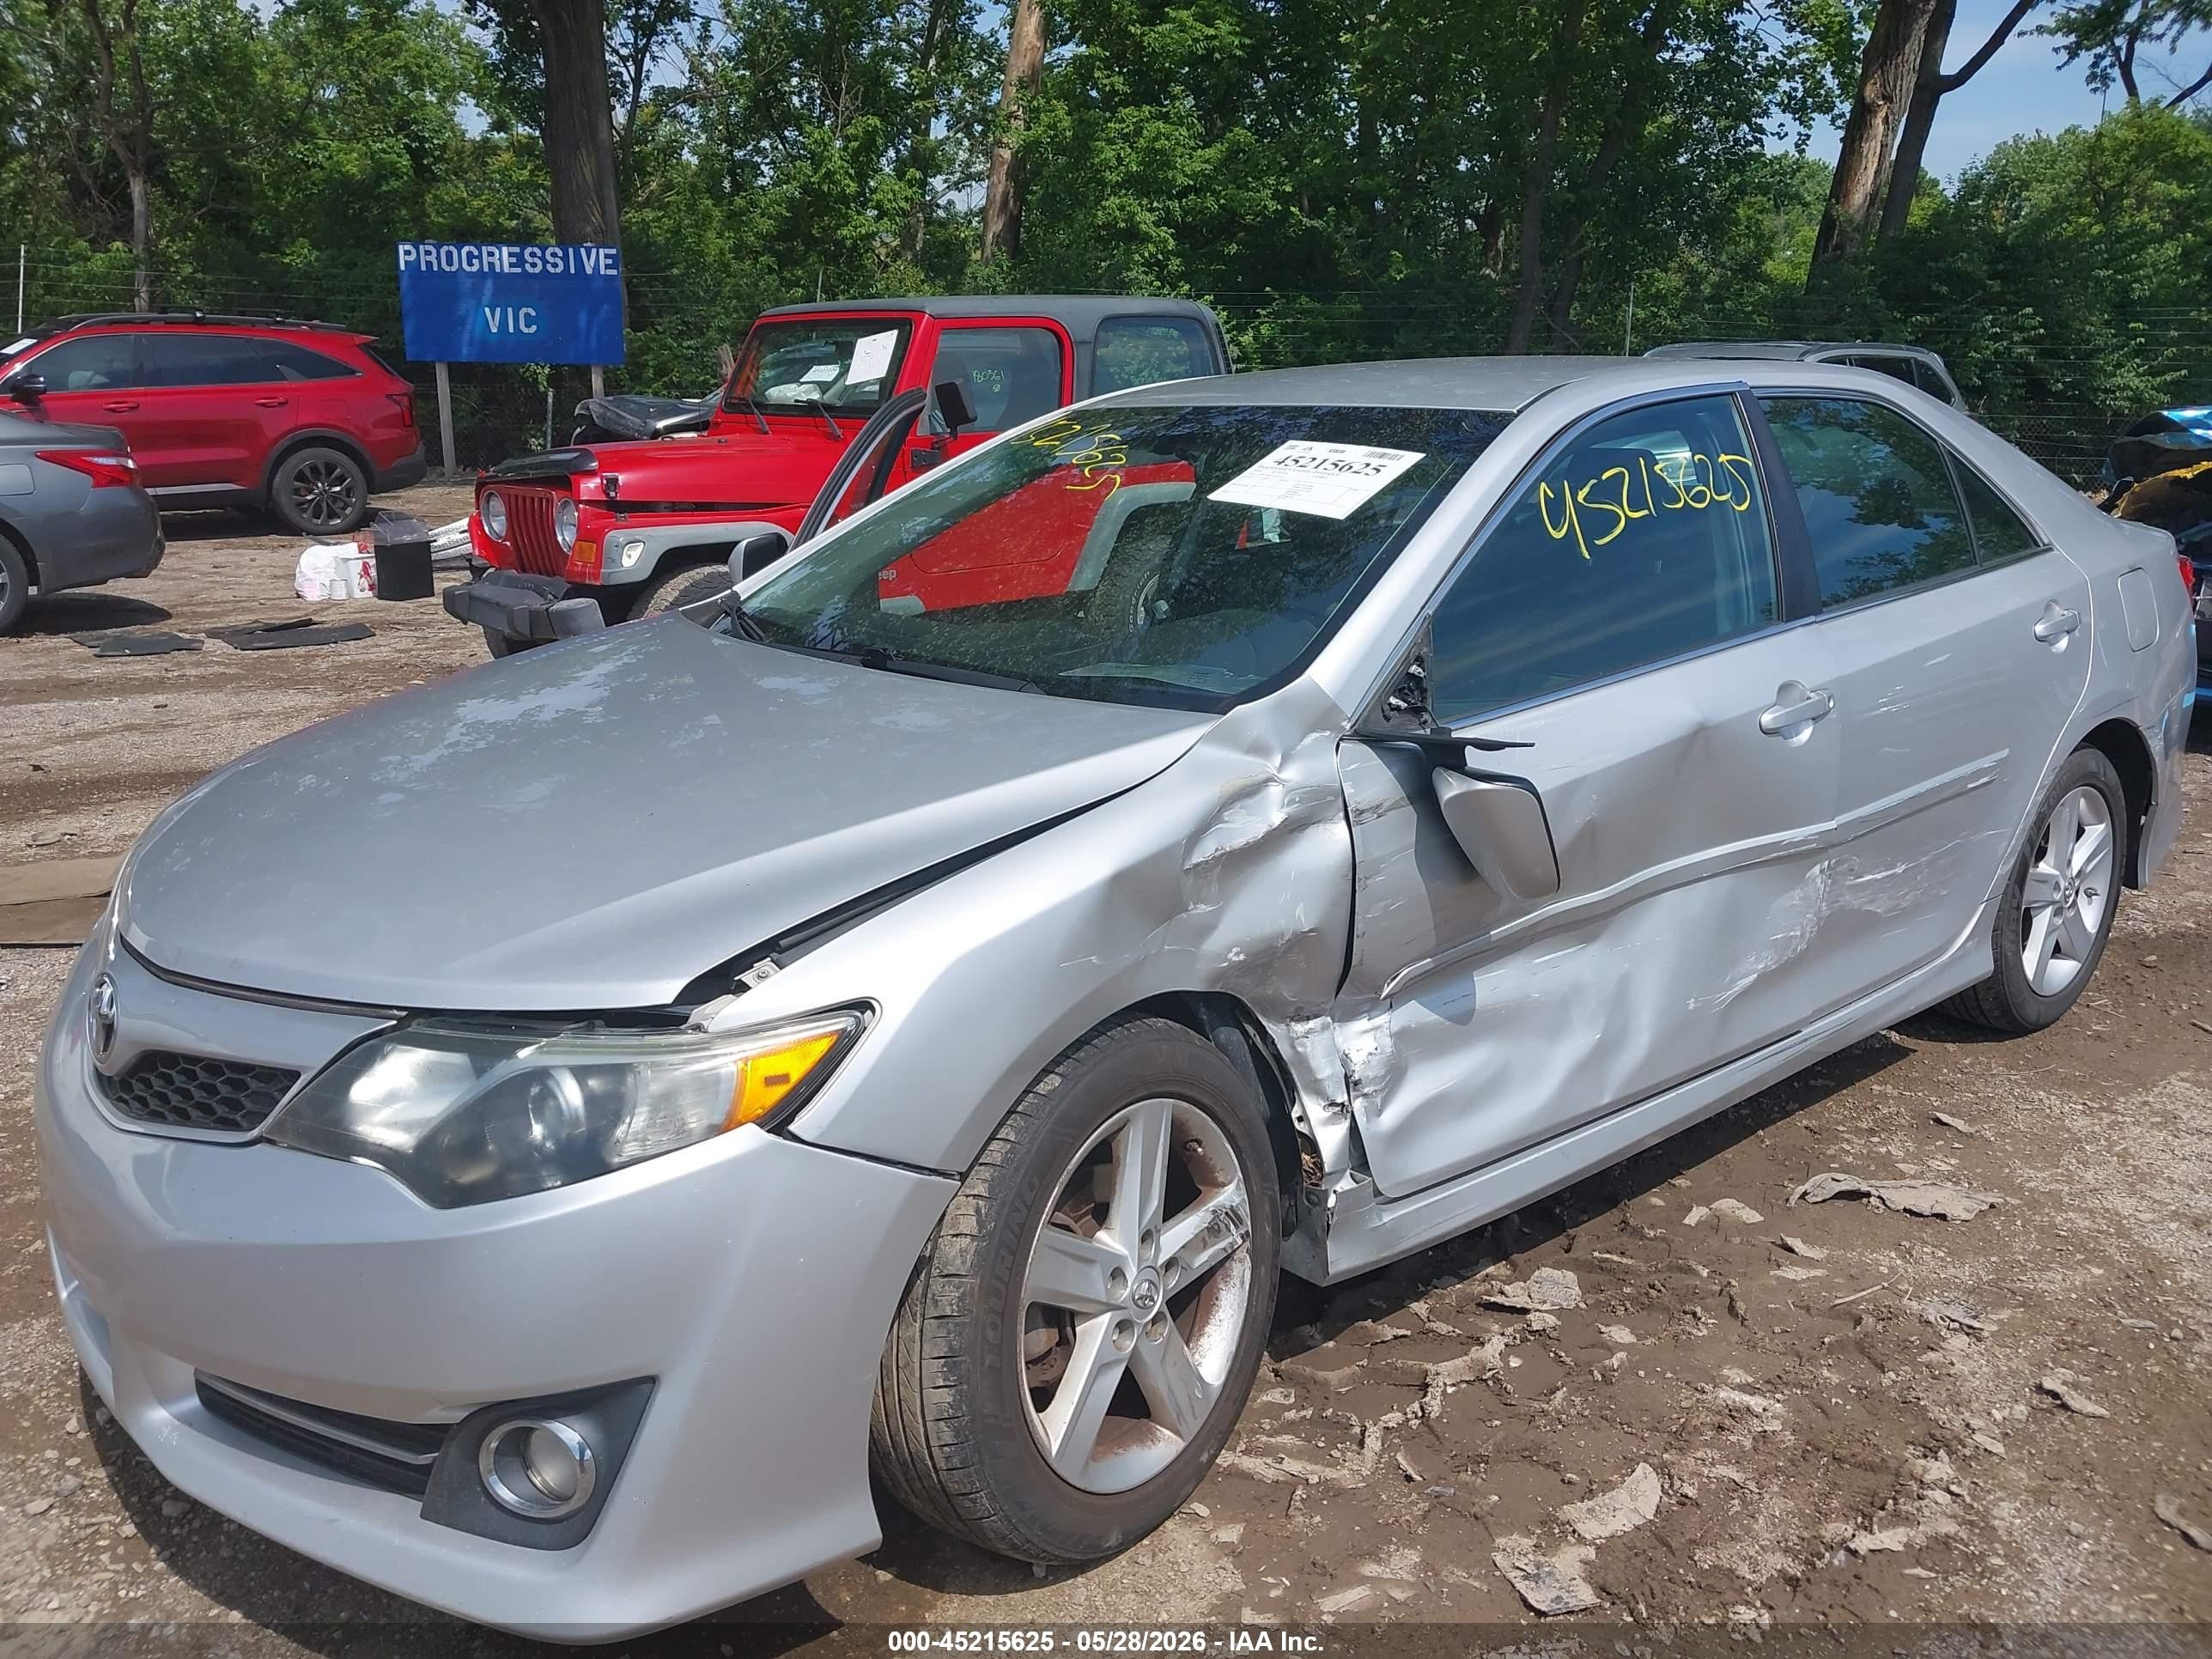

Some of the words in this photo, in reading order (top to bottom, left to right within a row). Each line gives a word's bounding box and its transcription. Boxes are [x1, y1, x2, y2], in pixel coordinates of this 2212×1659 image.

[398, 244, 618, 276] PROGRESSIVE
[484, 307, 538, 334] VIC
[1273, 455, 1389, 477] 45215625
[1540, 453, 1753, 560] 45215625
